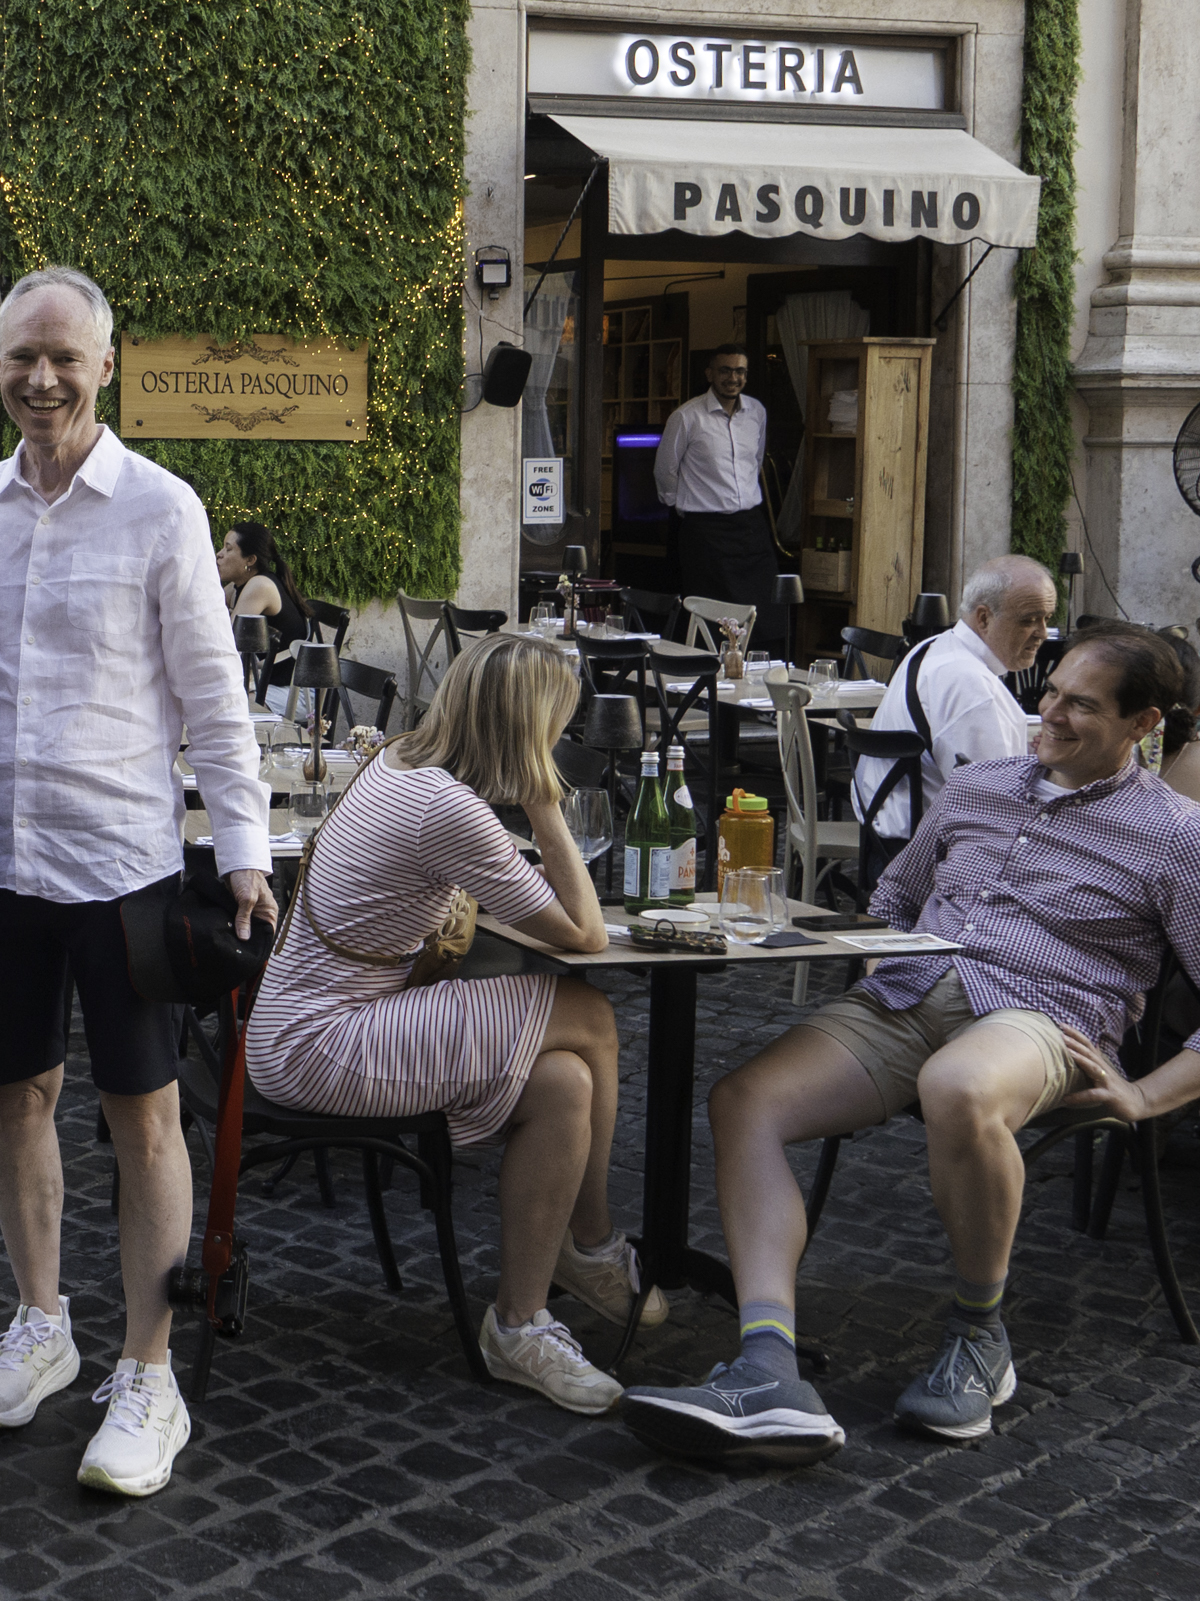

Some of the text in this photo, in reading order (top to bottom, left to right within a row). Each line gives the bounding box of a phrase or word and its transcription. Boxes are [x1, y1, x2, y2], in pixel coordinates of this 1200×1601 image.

[627, 39, 865, 95] OSTERIA
[672, 182, 981, 231] PASQUINO
[140, 370, 349, 399] OSTERIA PASQUINO
[533, 466, 554, 474] FREE
[532, 505, 555, 513] ZONE
